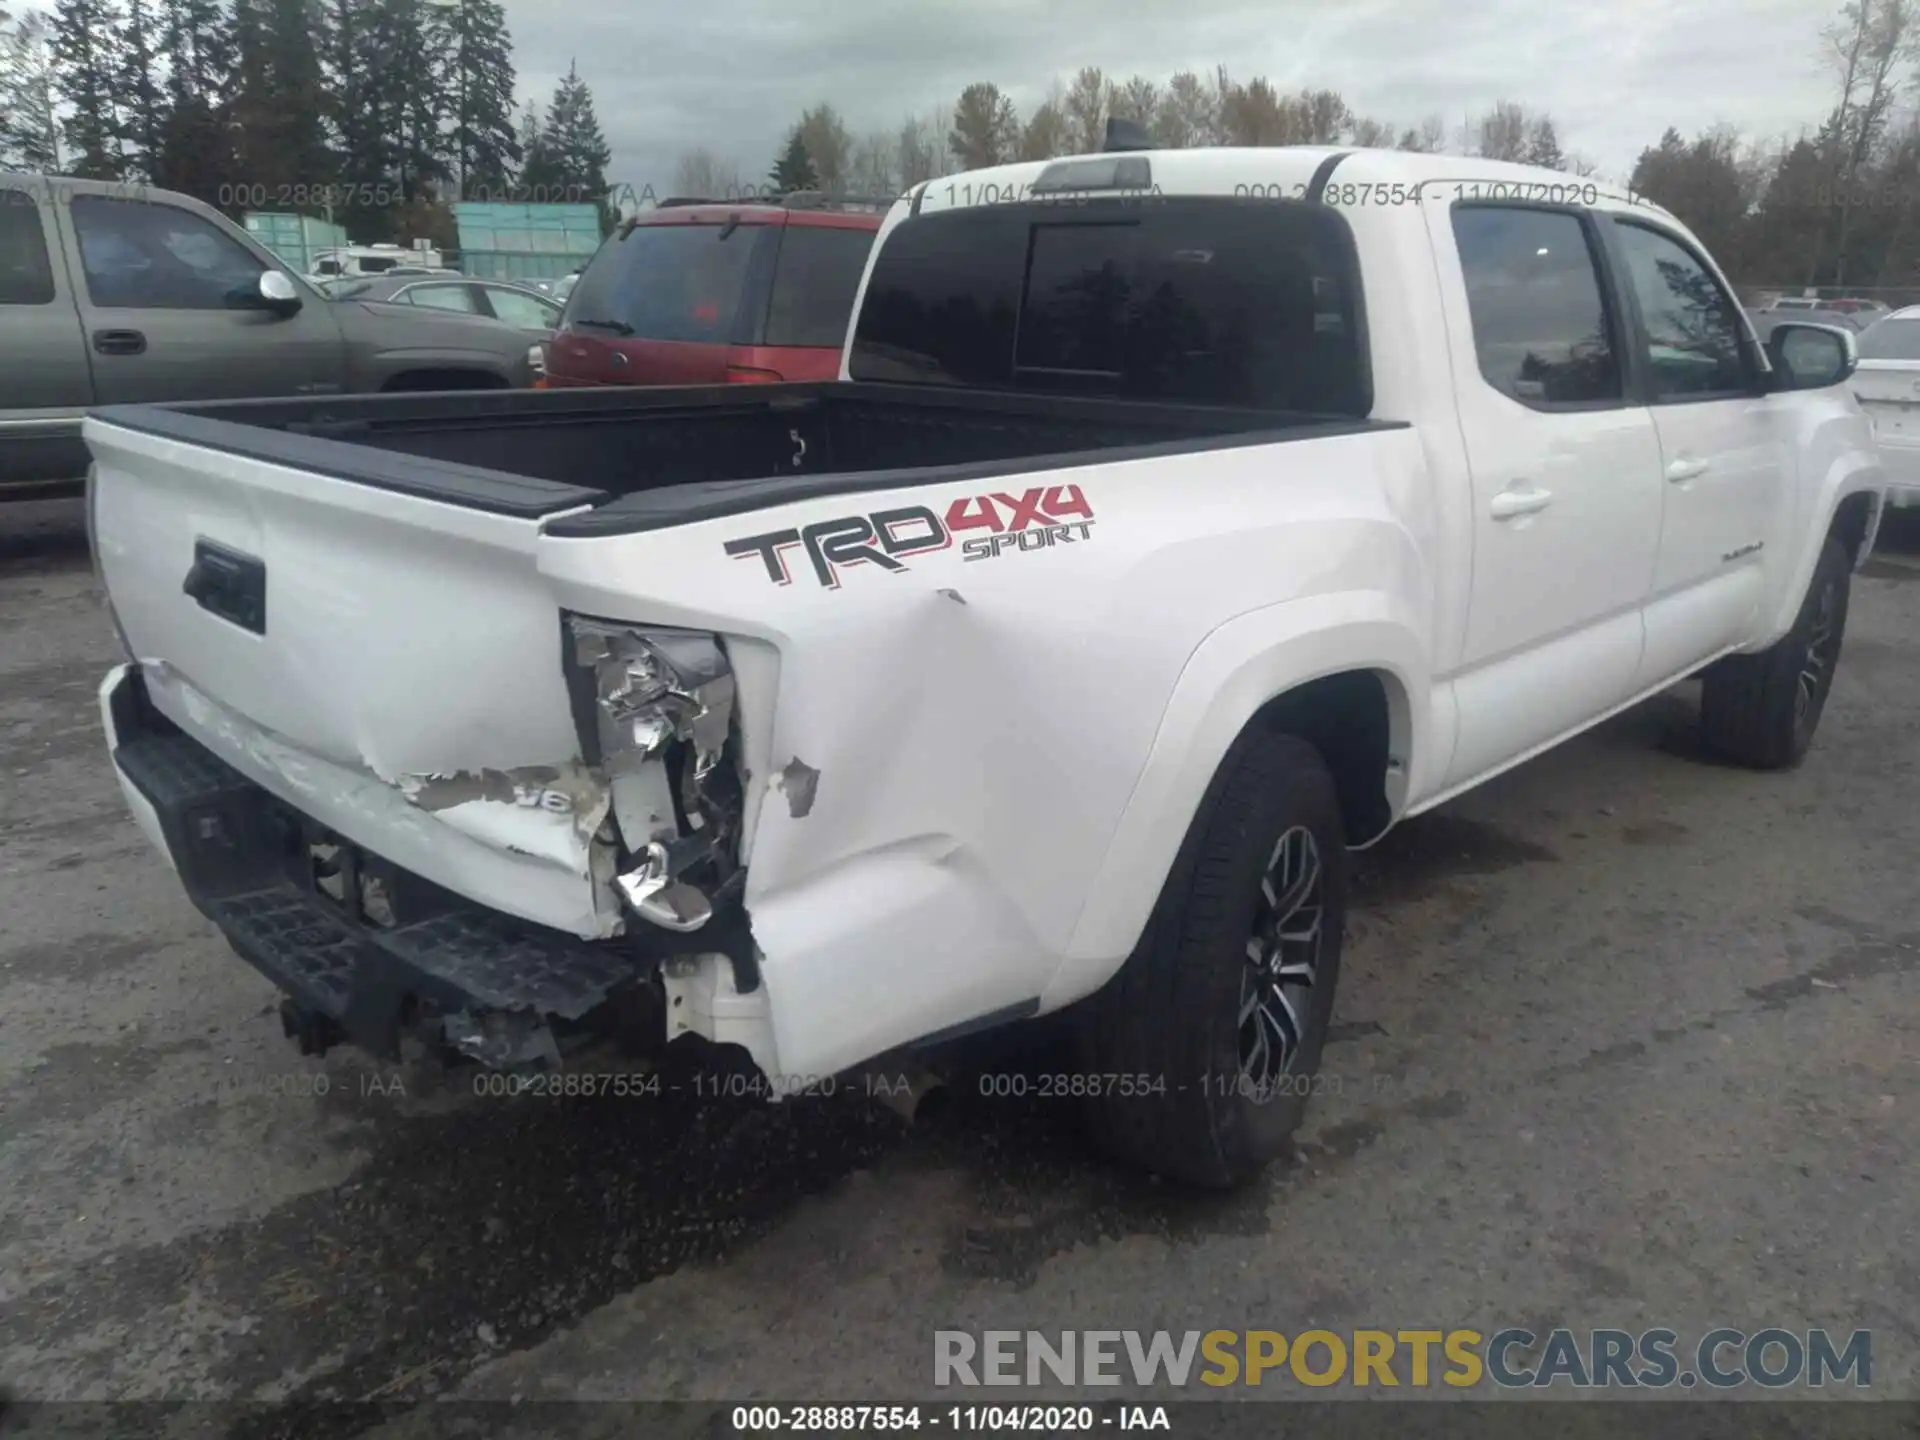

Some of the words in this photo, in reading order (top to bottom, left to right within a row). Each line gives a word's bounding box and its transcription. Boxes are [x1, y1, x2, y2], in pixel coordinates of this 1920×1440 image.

[723, 505, 953, 591] TRD
[944, 484, 1094, 533] 4X4
[962, 519, 1096, 562] SPORT
